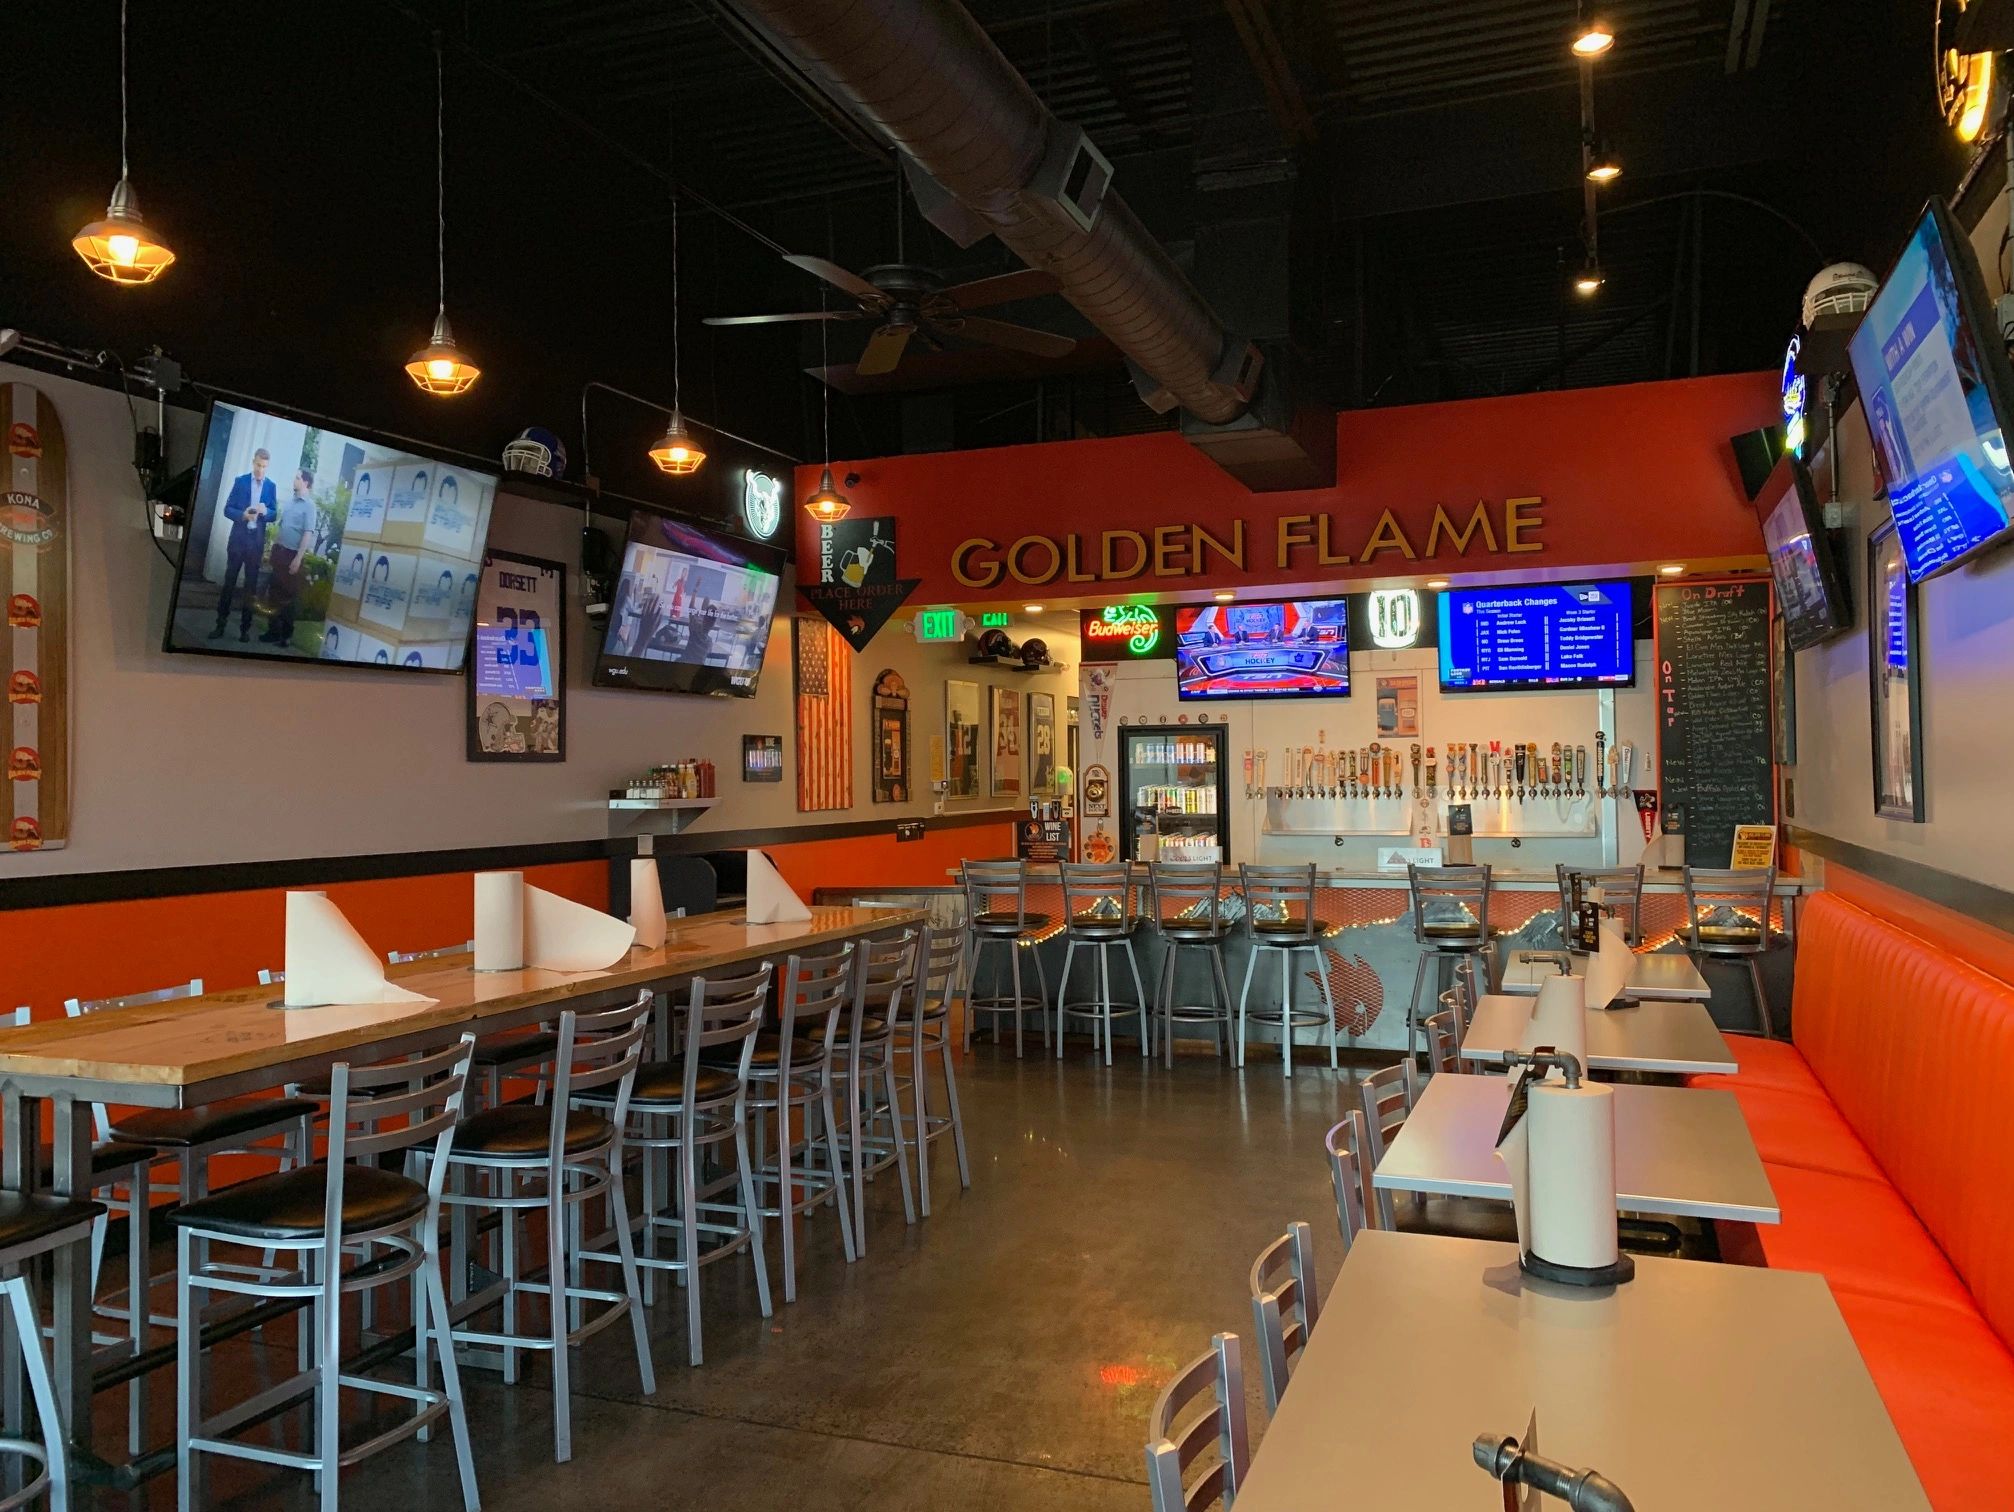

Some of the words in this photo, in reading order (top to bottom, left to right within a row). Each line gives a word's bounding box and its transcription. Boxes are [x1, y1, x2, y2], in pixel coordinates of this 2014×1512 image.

[7, 494, 40, 509] KONA
[0, 523, 40, 543] REWING
[950, 519, 1245, 589] GOLDEN
[1277, 496, 1545, 570] FLAME
[820, 524, 834, 583] BEER
[499, 571, 538, 594] DORSETT
[810, 587, 852, 599] PLACE
[856, 583, 904, 597] ORDER
[1681, 588, 1700, 601] On
[1705, 585, 1745, 599] Draft
[839, 599, 873, 610] HERE
[1476, 599, 1522, 609] Quarterback
[1524, 598, 1558, 607] Changes
[923, 610, 956, 639] EXIT
[1088, 620, 1159, 637] Budweiser
[497, 606, 541, 667] 33
[1037, 724, 1051, 755] 28
[1044, 822, 1061, 831] WINE
[1046, 833, 1060, 842] LIST
